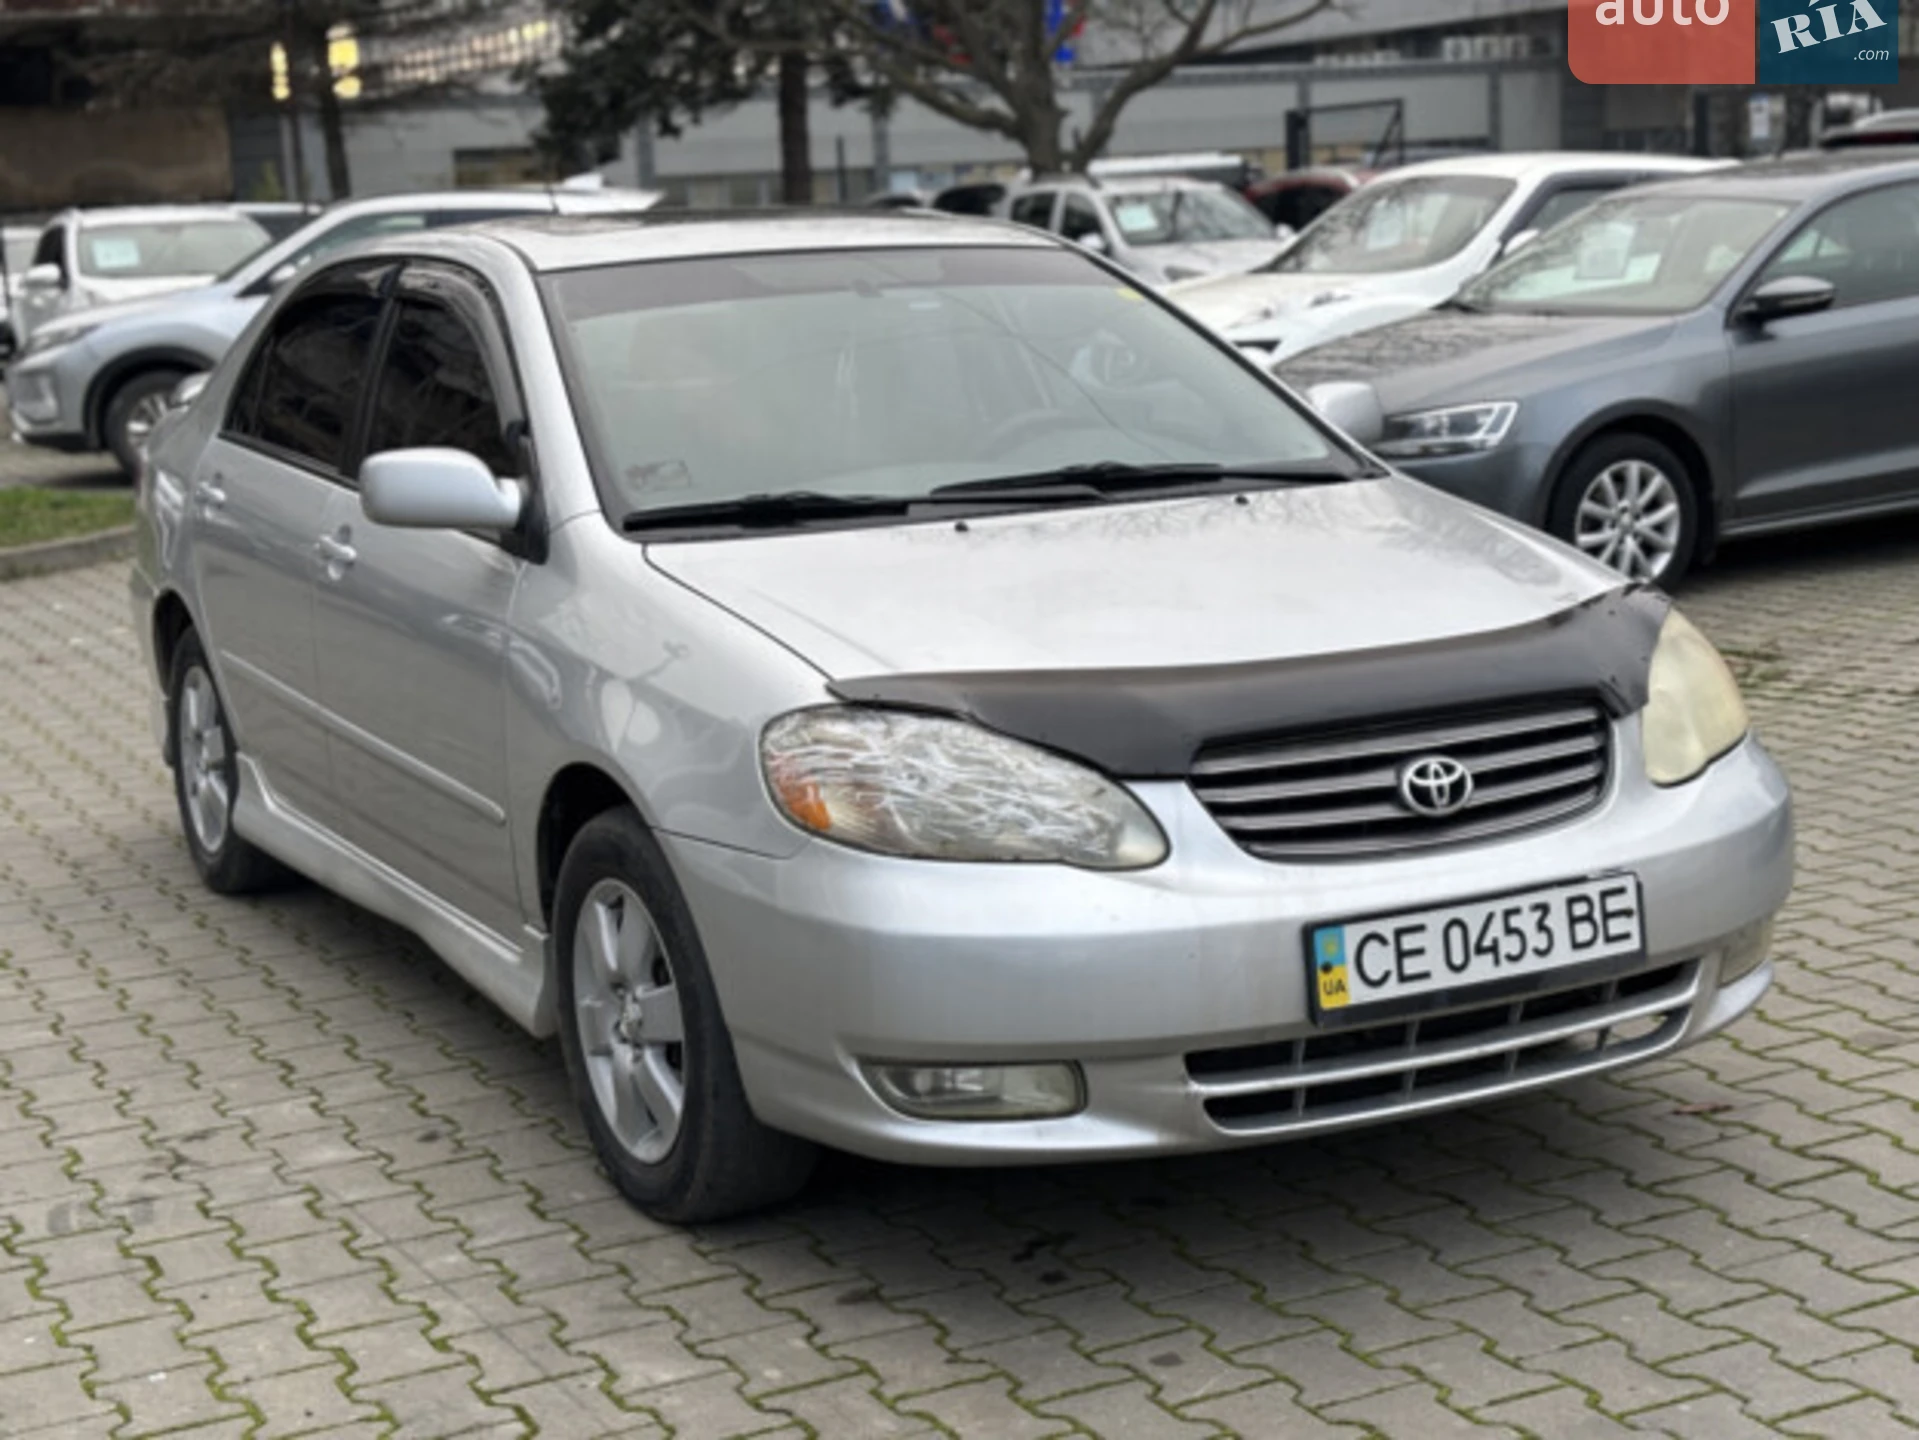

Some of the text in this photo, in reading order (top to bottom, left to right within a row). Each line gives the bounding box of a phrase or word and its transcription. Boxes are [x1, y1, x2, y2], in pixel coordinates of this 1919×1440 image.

[1354, 886, 1636, 988] CE 0453 BE
[1322, 979, 1347, 996] UA
